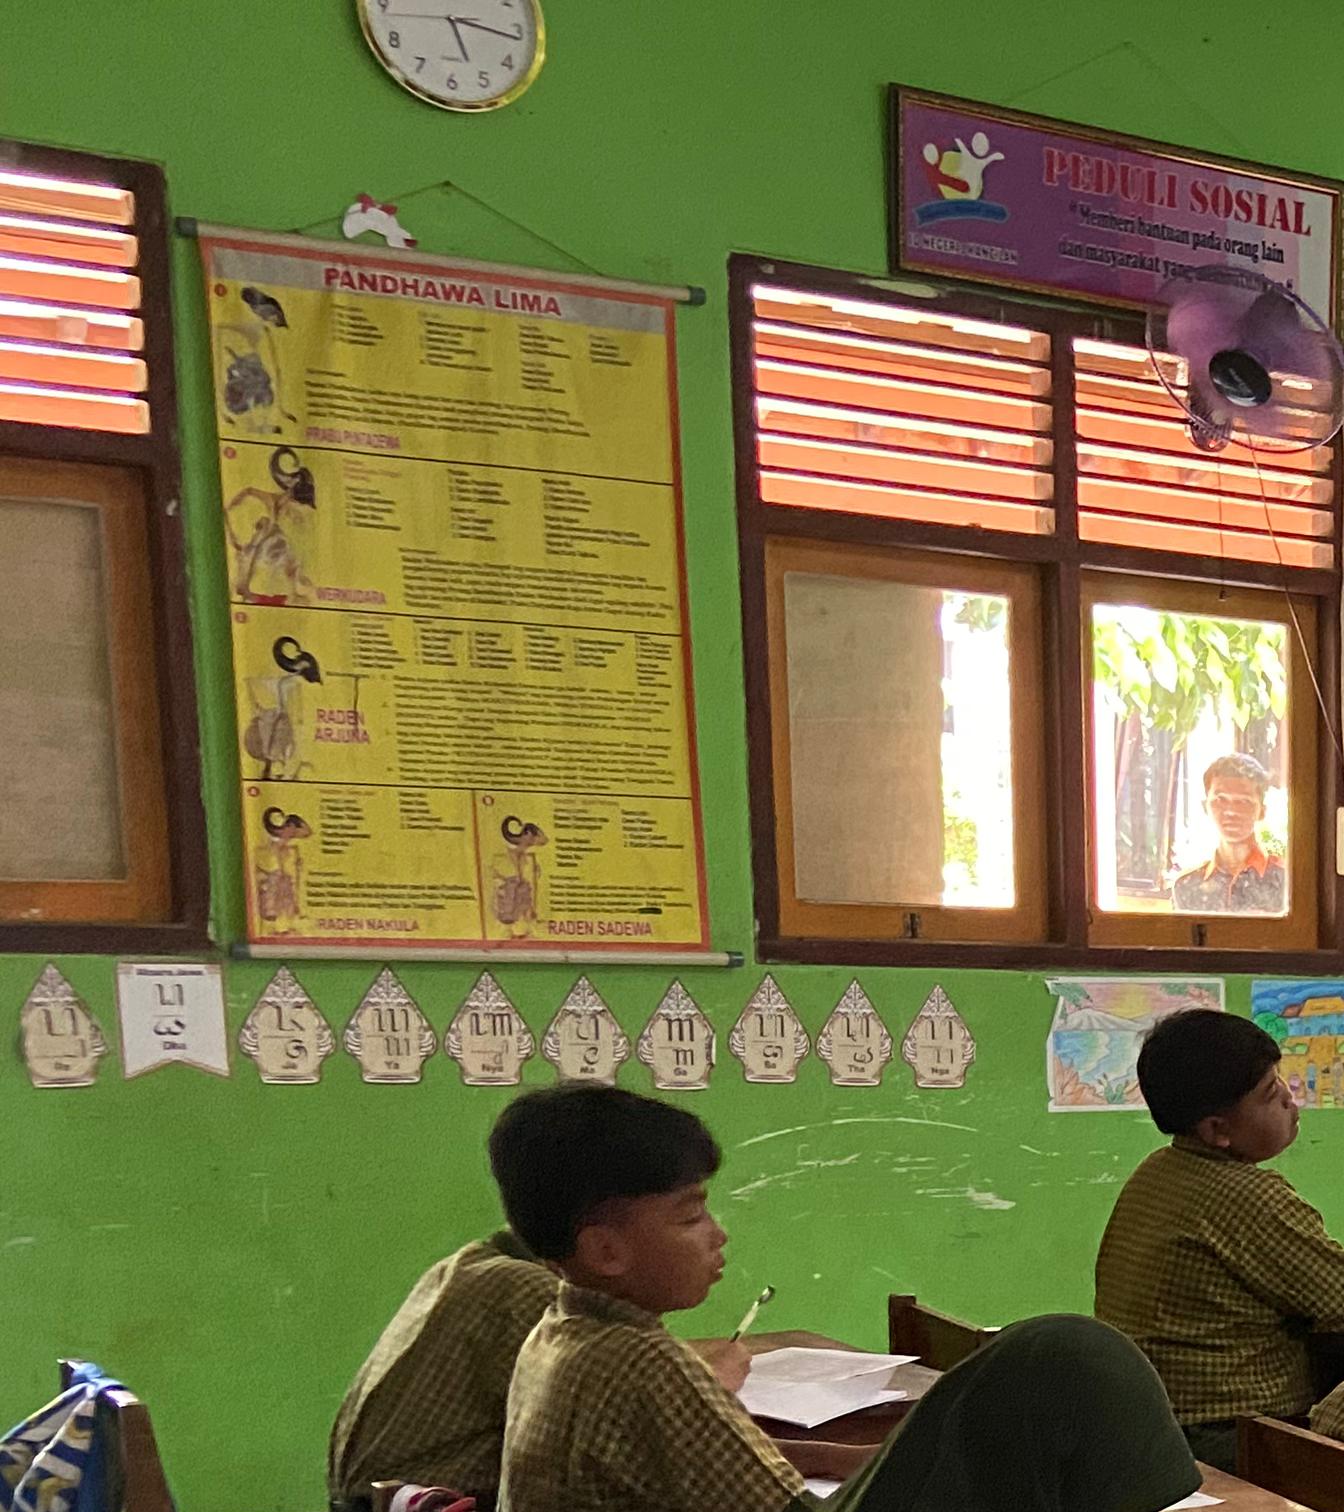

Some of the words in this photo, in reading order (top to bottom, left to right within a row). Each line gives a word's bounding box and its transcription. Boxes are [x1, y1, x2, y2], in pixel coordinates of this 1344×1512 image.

[388, 31, 400, 48] 8
[414, 56, 426, 73] 7
[501, 54, 513, 71] 4
[446, 75, 458, 90] 6
[478, 71, 490, 88] 5
[1043, 147, 1178, 208] PEDULI
[1189, 179, 1313, 237] SOSIAL
[1192, 230, 1222, 251] pada
[1223, 238, 1259, 264] orang
[1261, 241, 1285, 264] lain
[1085, 245, 1160, 274] masyarakat
[324, 267, 485, 307] PANDHAWA
[494, 290, 562, 318] LIMA
[317, 709, 366, 728] RADEN
[318, 919, 365, 932] RADEN
[368, 920, 420, 932] NAKULA
[549, 921, 596, 936] RADEN
[598, 922, 653, 937] SADEWA
